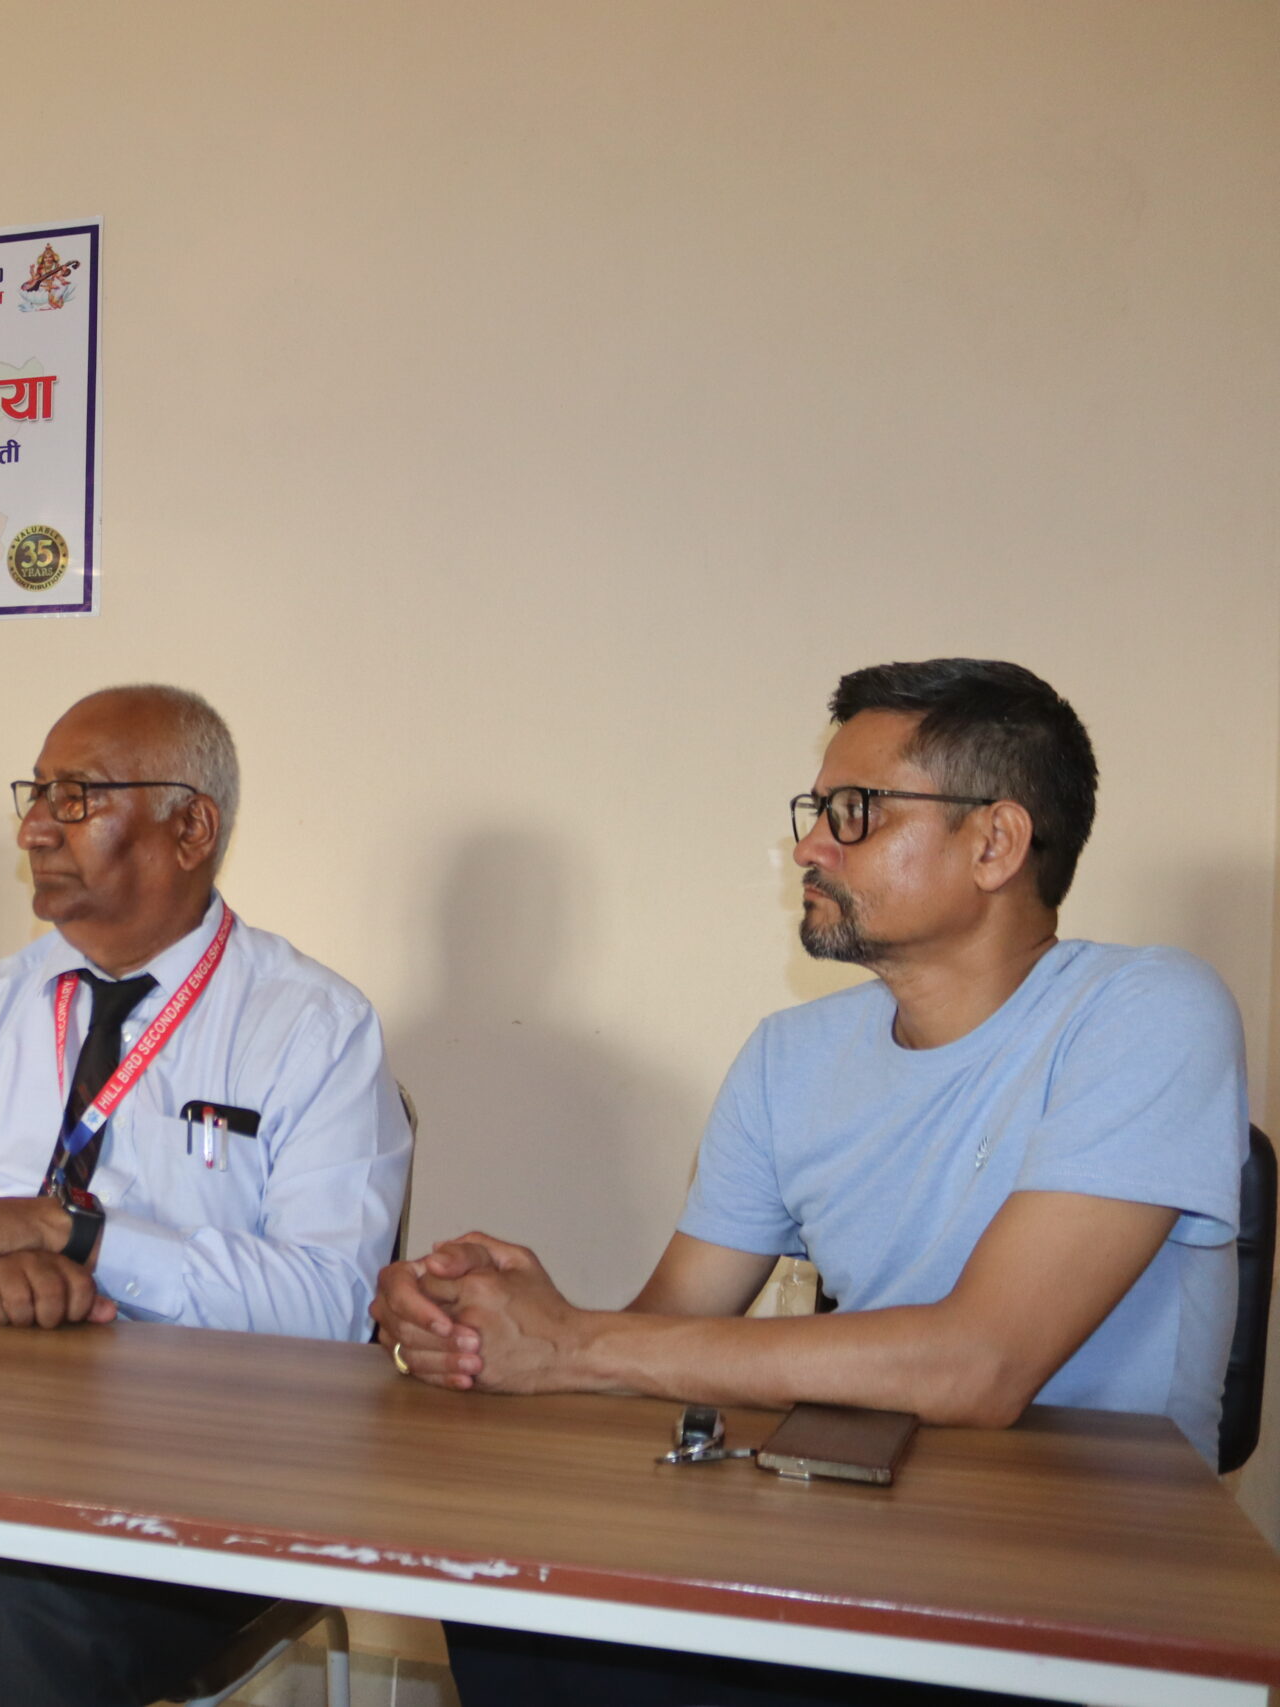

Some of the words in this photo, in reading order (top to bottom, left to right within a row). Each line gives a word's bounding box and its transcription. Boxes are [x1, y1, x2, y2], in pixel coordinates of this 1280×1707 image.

[21, 539, 54, 569] 35
[21, 567, 53, 578] YEARS
[97, 1083, 123, 1110] HILL
[116, 1052, 143, 1084] BIRD
[138, 985, 193, 1055] SECONDARY
[188, 940, 222, 990] ENGLISH
